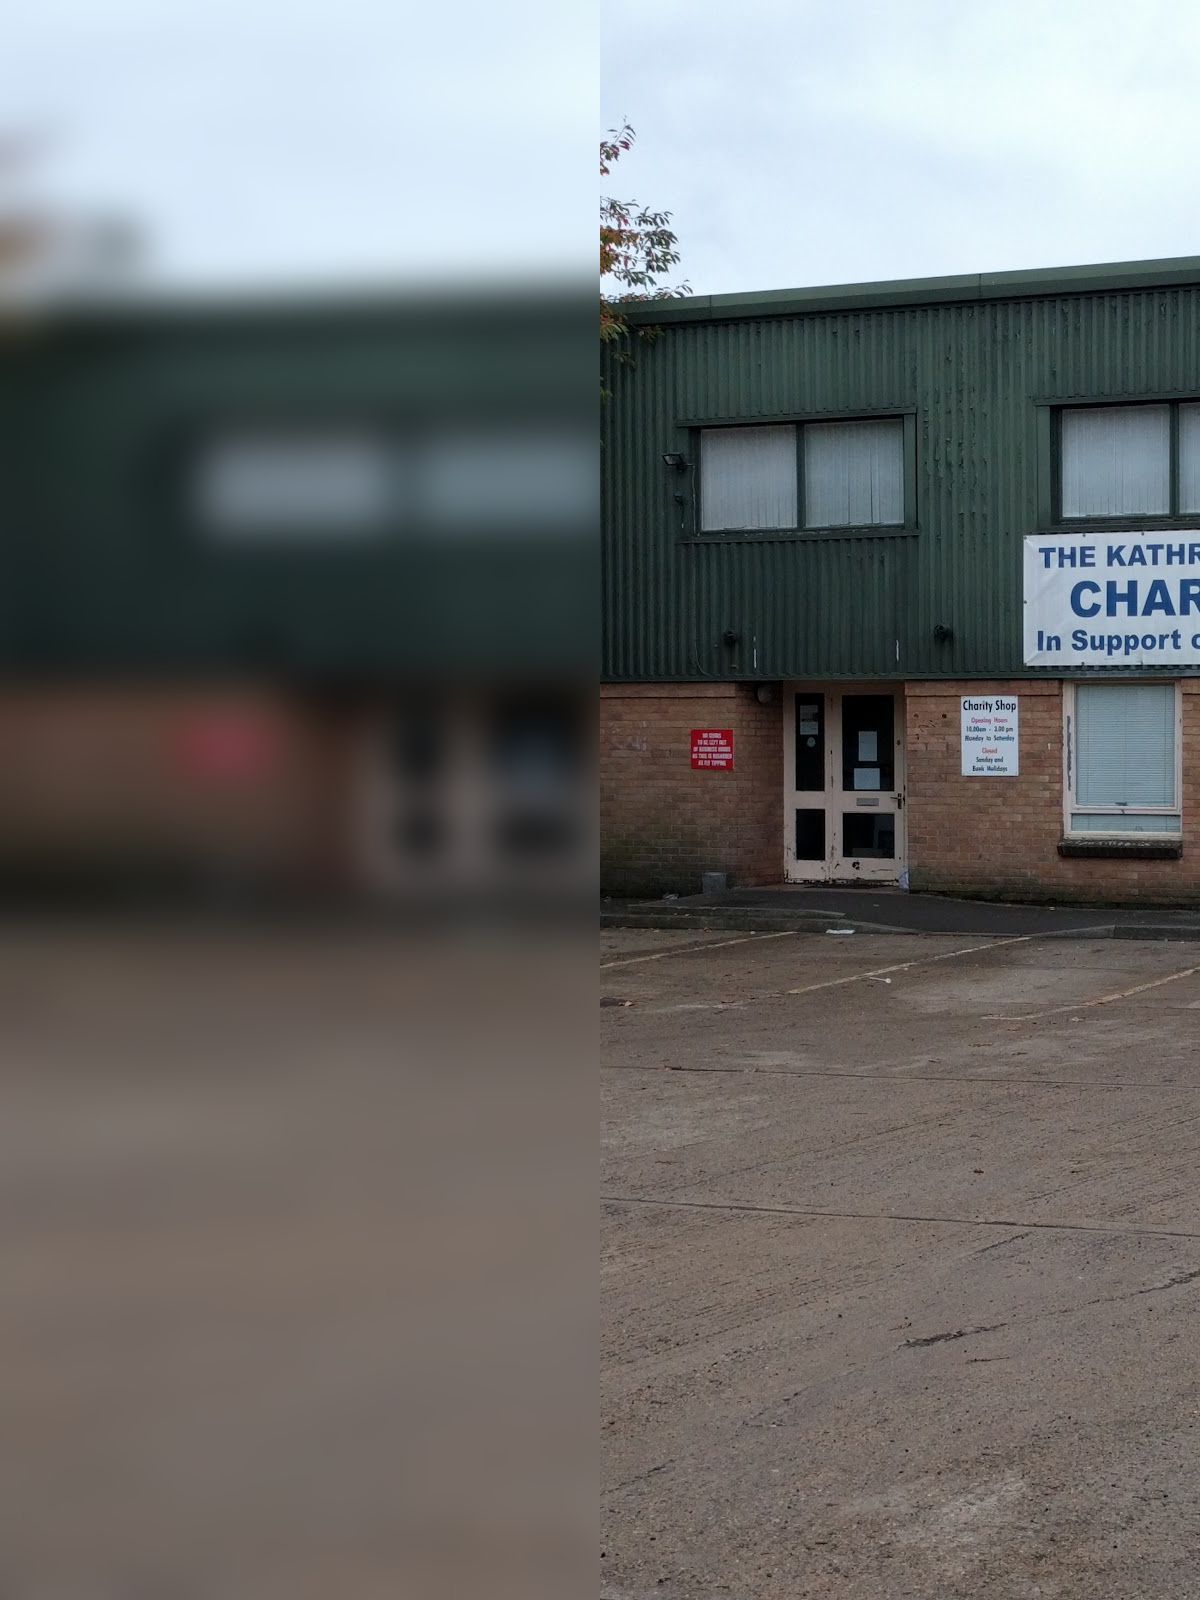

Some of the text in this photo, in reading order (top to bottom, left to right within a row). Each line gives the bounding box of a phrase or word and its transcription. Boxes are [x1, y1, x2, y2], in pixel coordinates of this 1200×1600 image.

[1038, 546, 1096, 568] THE
[1037, 630, 1061, 652] In
[1071, 628, 1181, 656] Support
[963, 700, 1017, 713] Charity Shop
